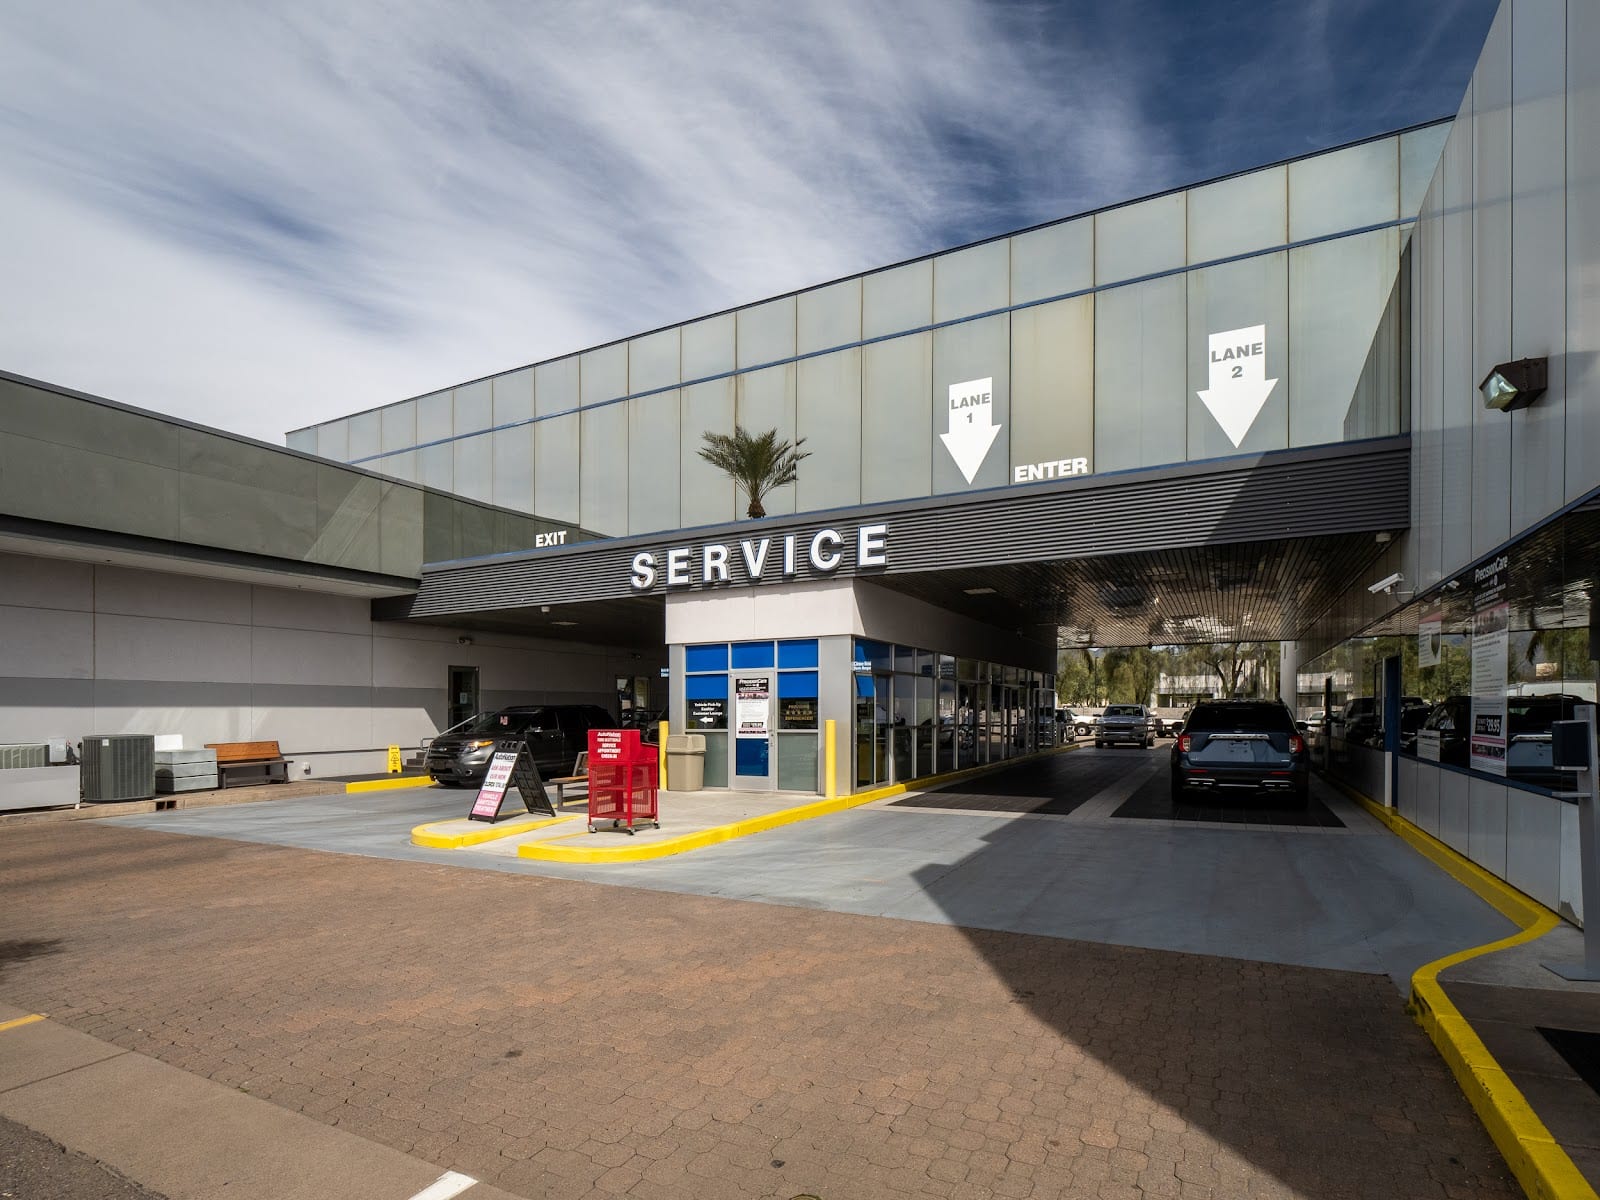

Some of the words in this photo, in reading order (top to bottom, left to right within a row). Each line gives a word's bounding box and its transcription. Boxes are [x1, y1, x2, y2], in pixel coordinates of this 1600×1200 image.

[1211, 342, 1263, 363] LANE
[1231, 365, 1243, 379] 2
[950, 392, 991, 410] LANE
[966, 412, 973, 424] 1
[1014, 457, 1089, 483] ENTER
[535, 530, 567, 548] EXIT
[631, 524, 888, 589] SERVICE
